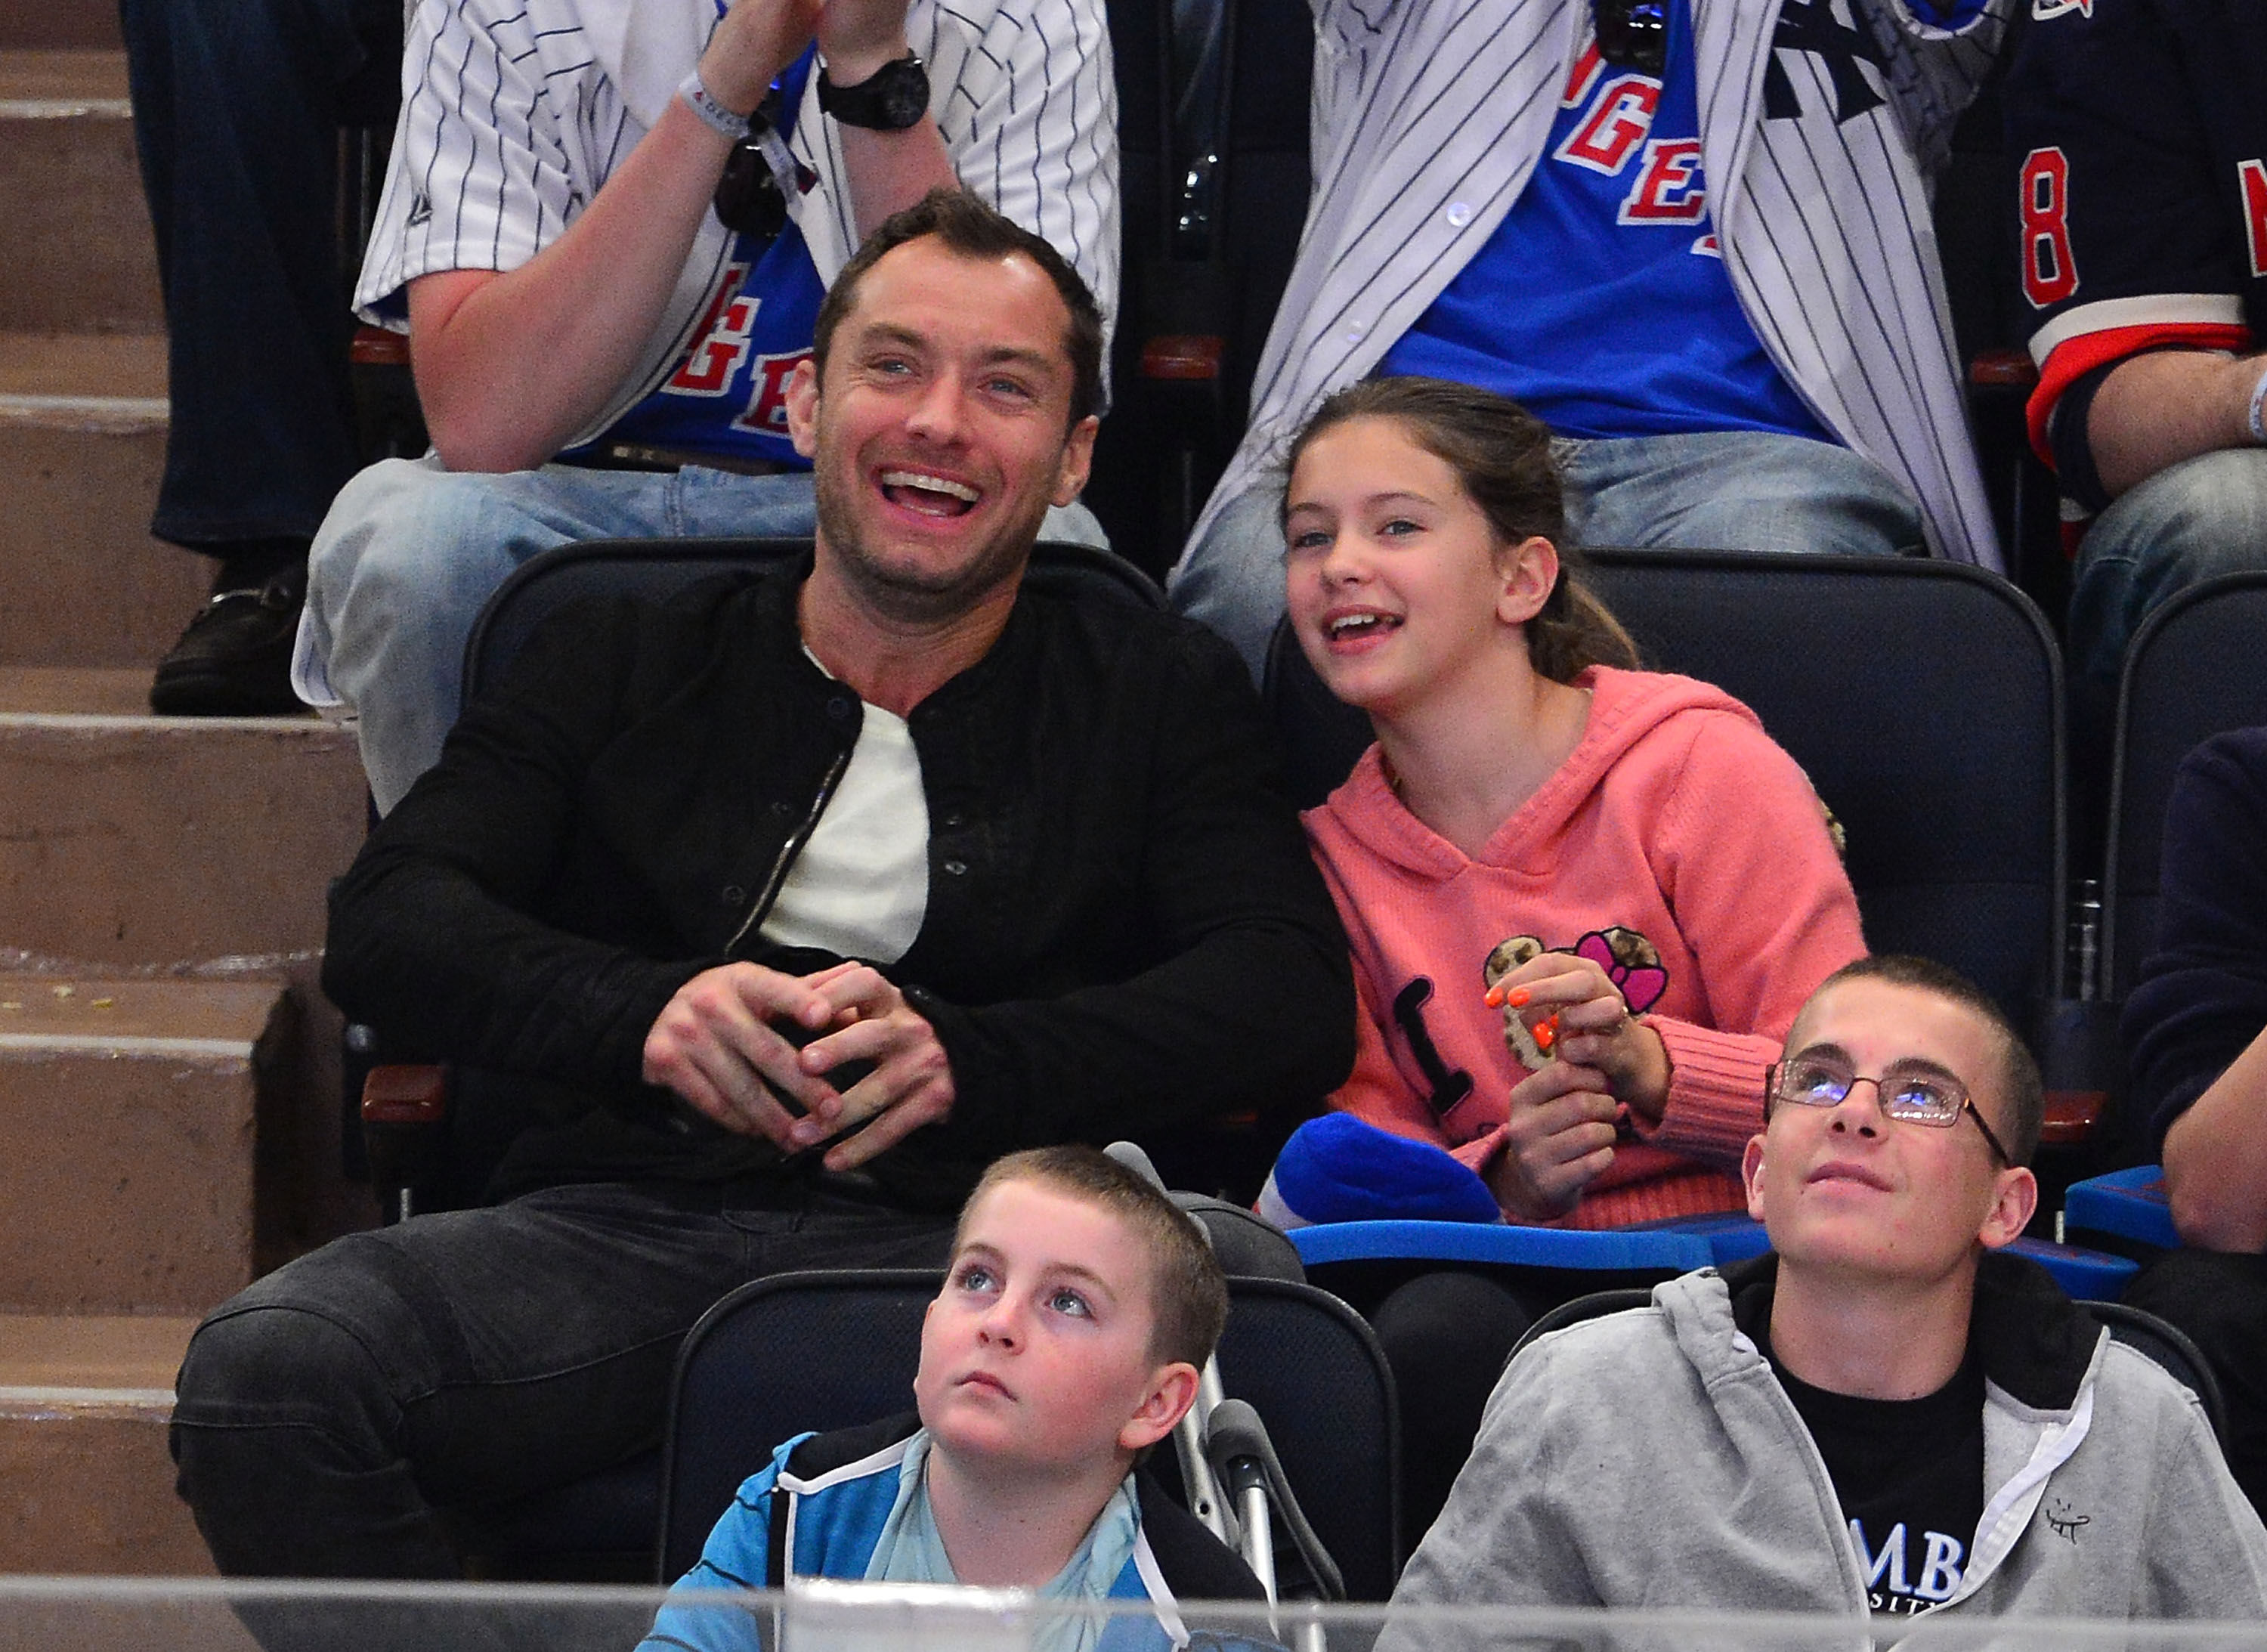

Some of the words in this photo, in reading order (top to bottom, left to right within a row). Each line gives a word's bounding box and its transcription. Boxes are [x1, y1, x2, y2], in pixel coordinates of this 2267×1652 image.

[1553, 38, 1723, 258] GE
[2020, 146, 2080, 310] 8
[1870, 1592, 1937, 1616] SIT
